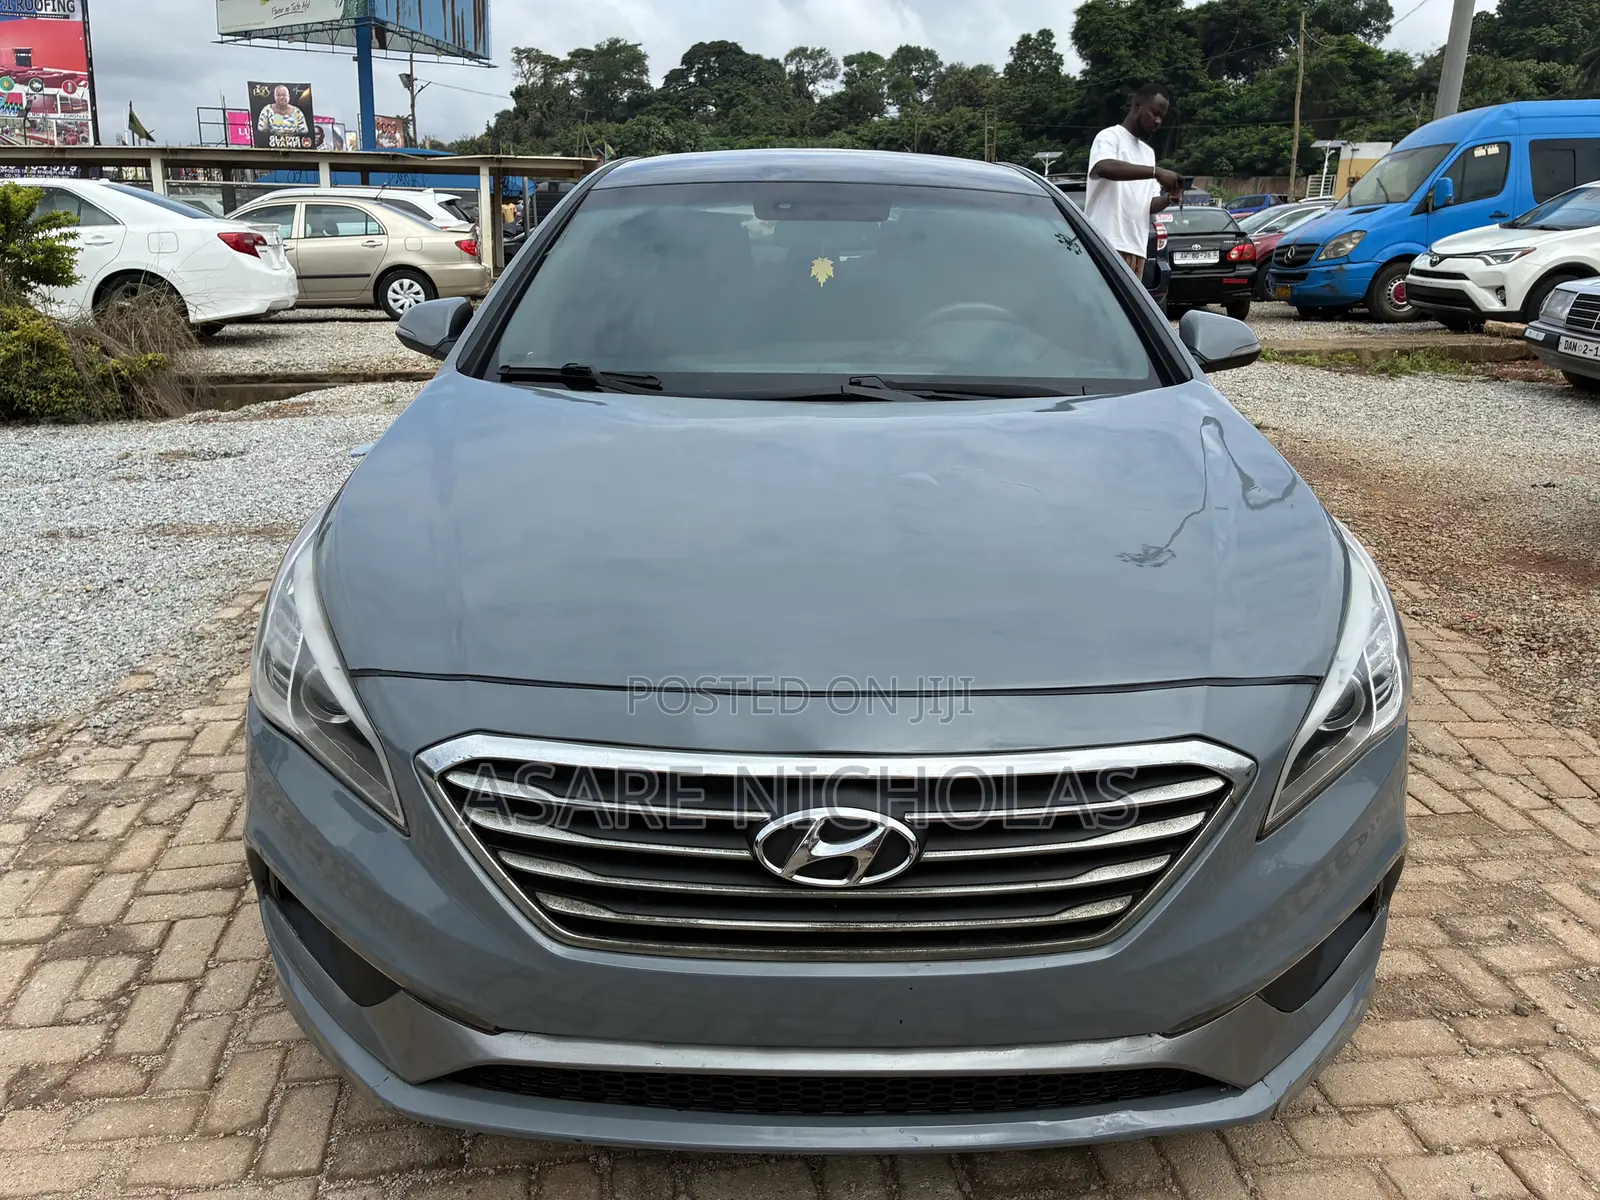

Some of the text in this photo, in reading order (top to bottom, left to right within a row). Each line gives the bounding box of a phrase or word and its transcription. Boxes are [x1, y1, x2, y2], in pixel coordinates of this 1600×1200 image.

[16, 0, 75, 13] ROOFING
[1564, 340, 1600, 357] DAN 2-1
